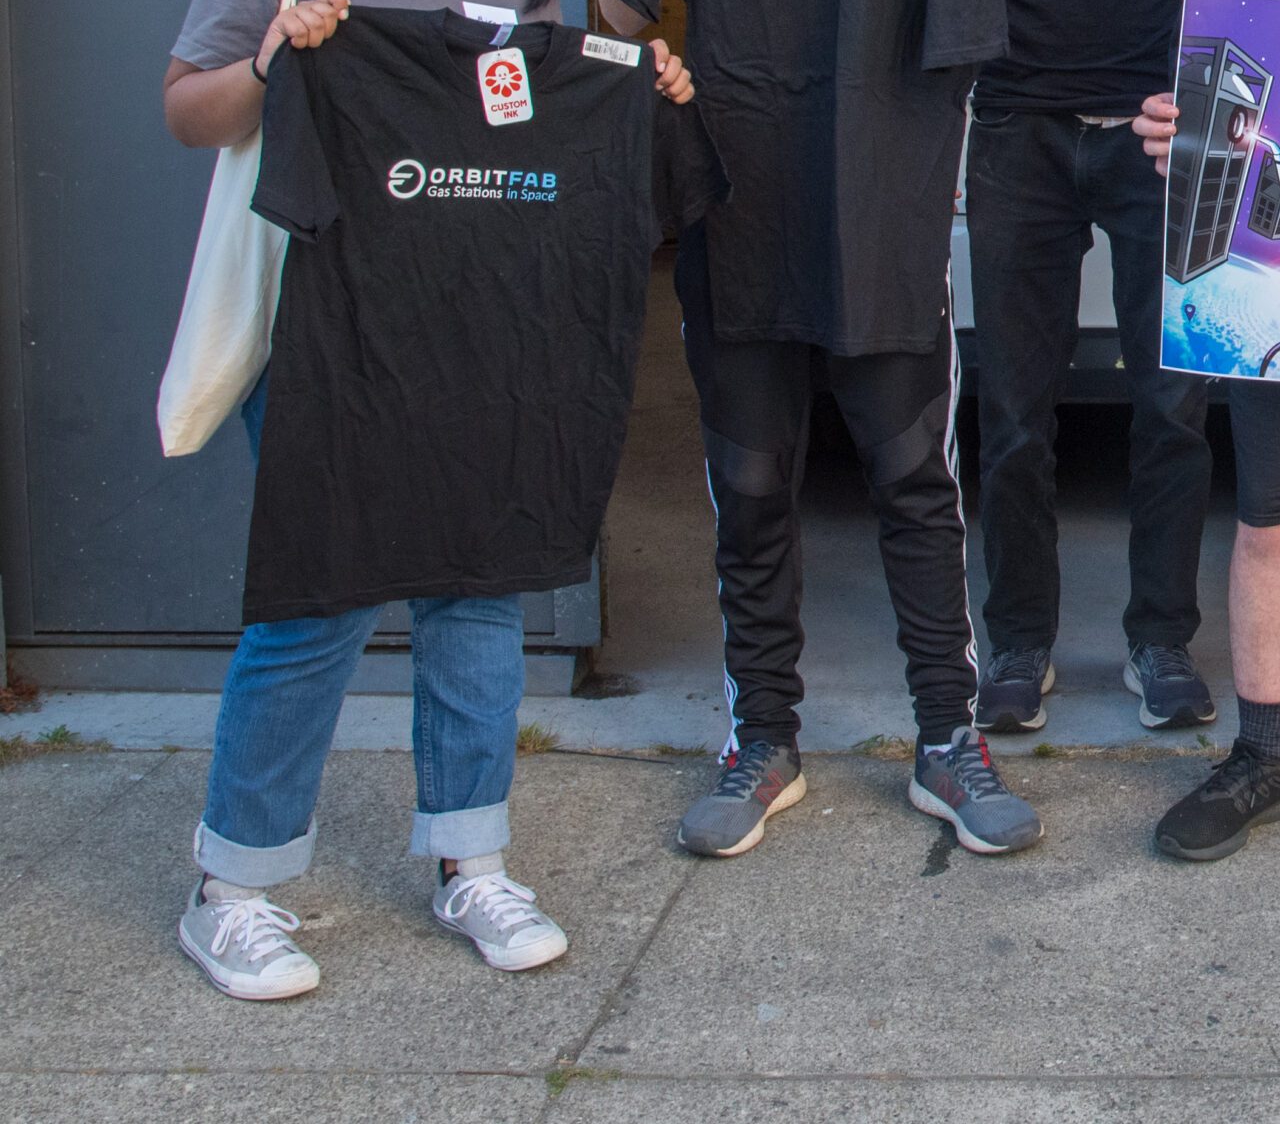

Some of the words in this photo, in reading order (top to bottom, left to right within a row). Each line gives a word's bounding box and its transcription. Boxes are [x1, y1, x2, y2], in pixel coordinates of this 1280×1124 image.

[490, 99, 528, 113] CUSTOM
[503, 110, 519, 119] INK
[427, 185, 450, 198] Gas
[453, 185, 503, 199] Stations
[506, 188, 518, 200] in
